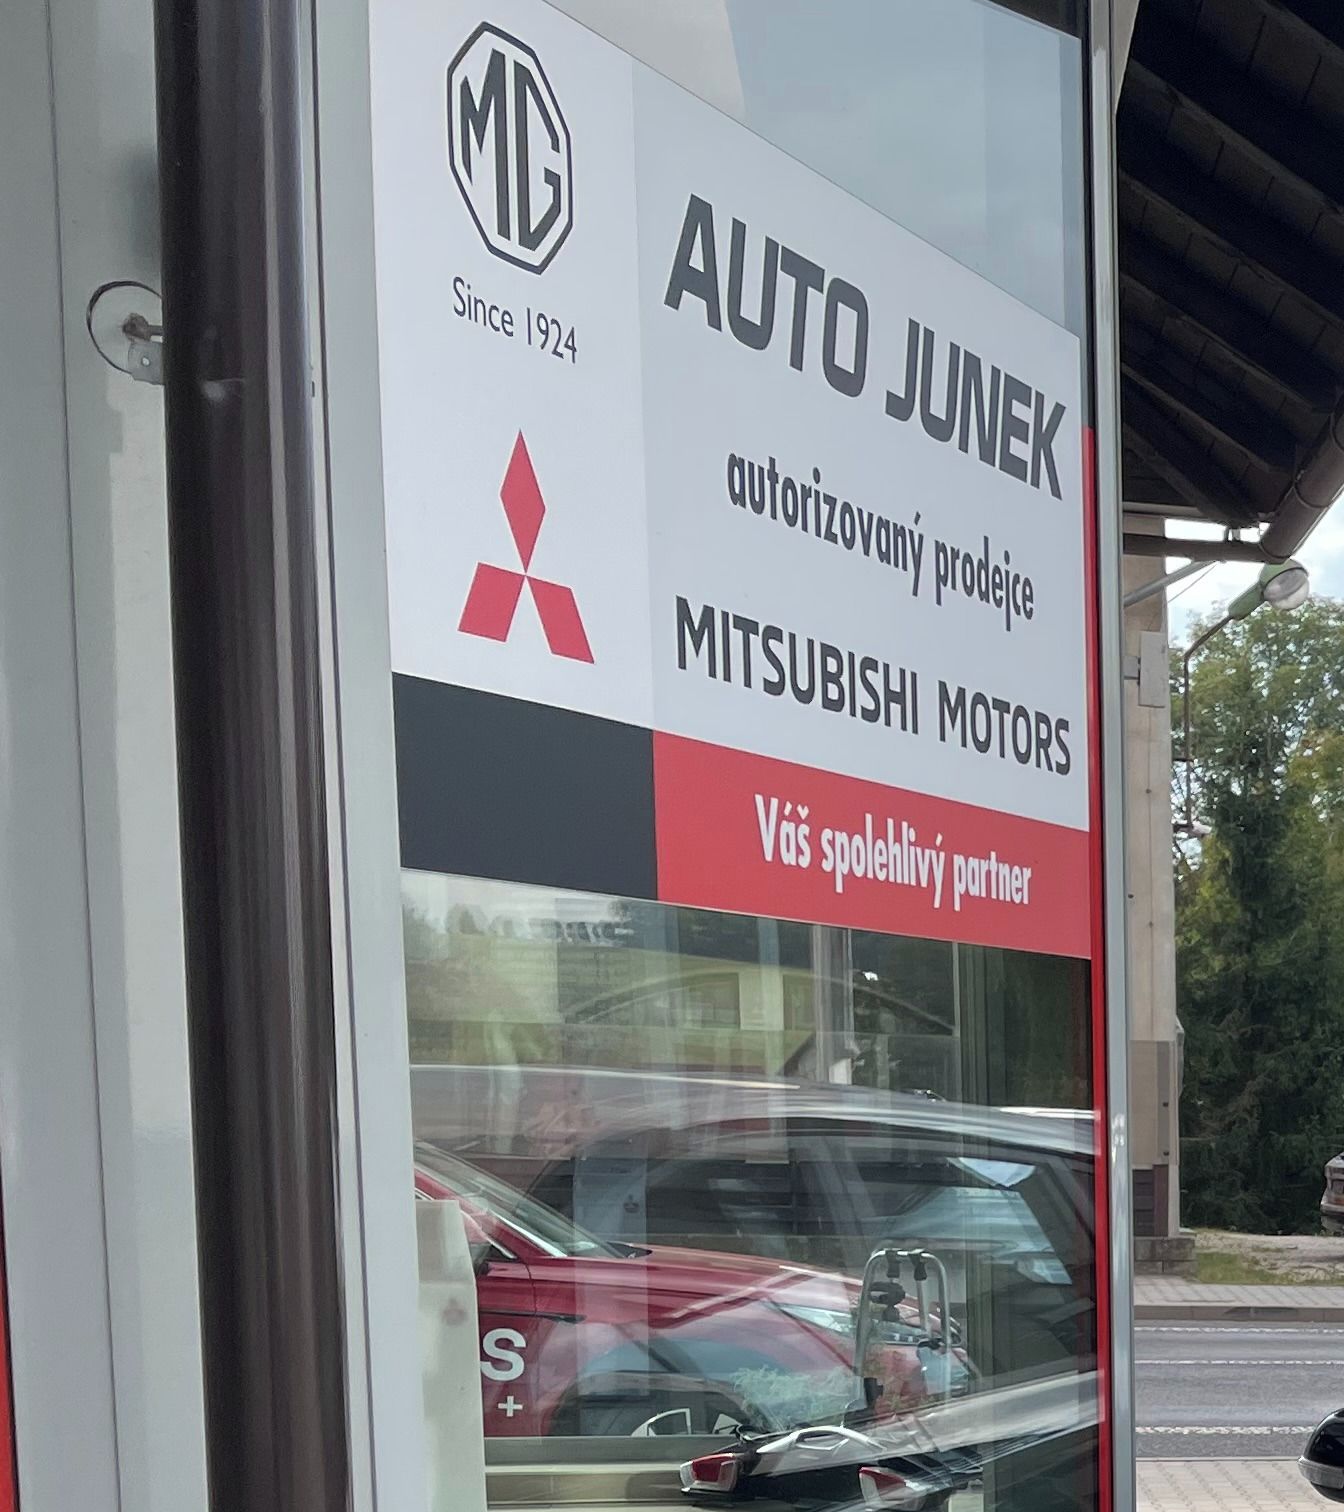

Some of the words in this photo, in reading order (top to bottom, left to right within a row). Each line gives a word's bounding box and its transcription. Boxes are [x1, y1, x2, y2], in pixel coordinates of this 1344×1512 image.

[459, 47, 562, 253] MG
[452, 276, 515, 338] Since
[526, 306, 578, 365] 1924
[663, 192, 869, 398] AUTO
[885, 316, 1067, 501] JUNEK
[727, 452, 924, 598] autorizovaný
[934, 535, 1035, 633] prodejce
[675, 594, 920, 735] MITSUBISHI
[937, 680, 1072, 776] MOTORS
[754, 793, 812, 869] Váš
[820, 812, 946, 909] spolehlivý
[953, 850, 1032, 912] partner
